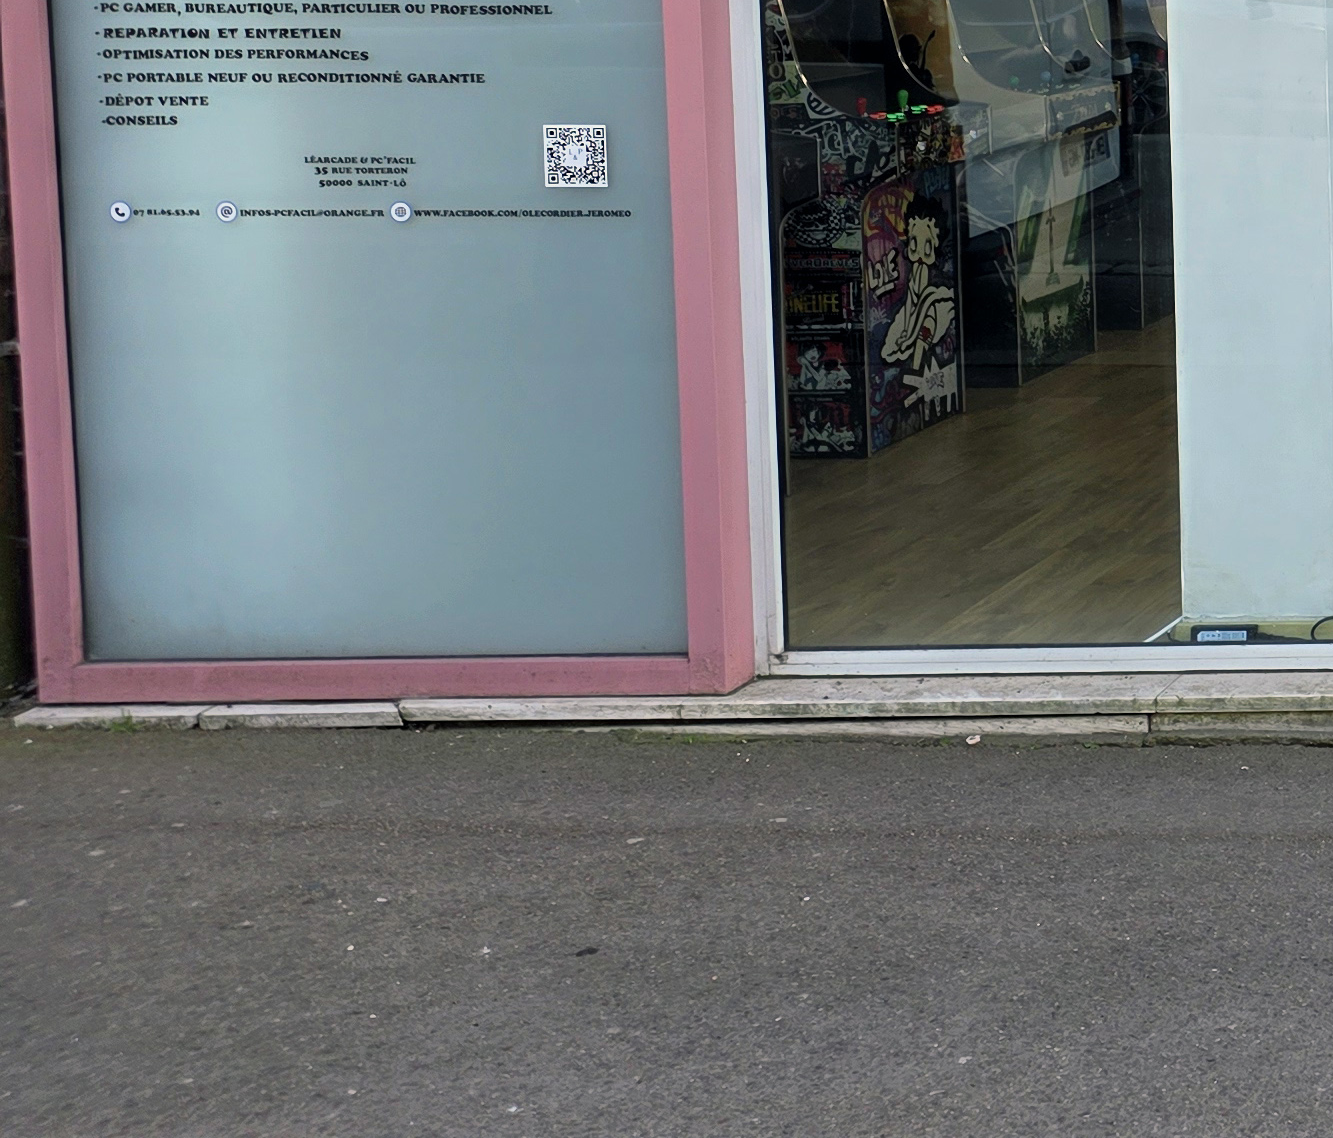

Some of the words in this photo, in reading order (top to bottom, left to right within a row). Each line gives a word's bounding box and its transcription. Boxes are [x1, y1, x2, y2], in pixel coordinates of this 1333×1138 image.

[123, 2, 181, 16] GAMER,
[185, 3, 297, 15] BUREAUTIQUE,
[302, 3, 401, 14] PARTICULIER
[405, 4, 425, 14] OU
[430, 4, 553, 15] PROFESSIONNEL
[217, 28, 238, 39] ET
[244, 28, 341, 39] ENTRETIEN
[214, 49, 243, 59] DES
[247, 49, 369, 61] PERFORMANCES
[127, 73, 203, 83] PORTABLE
[208, 73, 248, 83] NEUF
[252, 73, 272, 83] OU
[277, 70, 402, 83] RECONDITIONNÉ
[407, 73, 485, 83] GARANTIE
[158, 96, 209, 106] VENTE
[304, 155, 358, 164] LÉARCADE
[314, 167, 328, 175] 35
